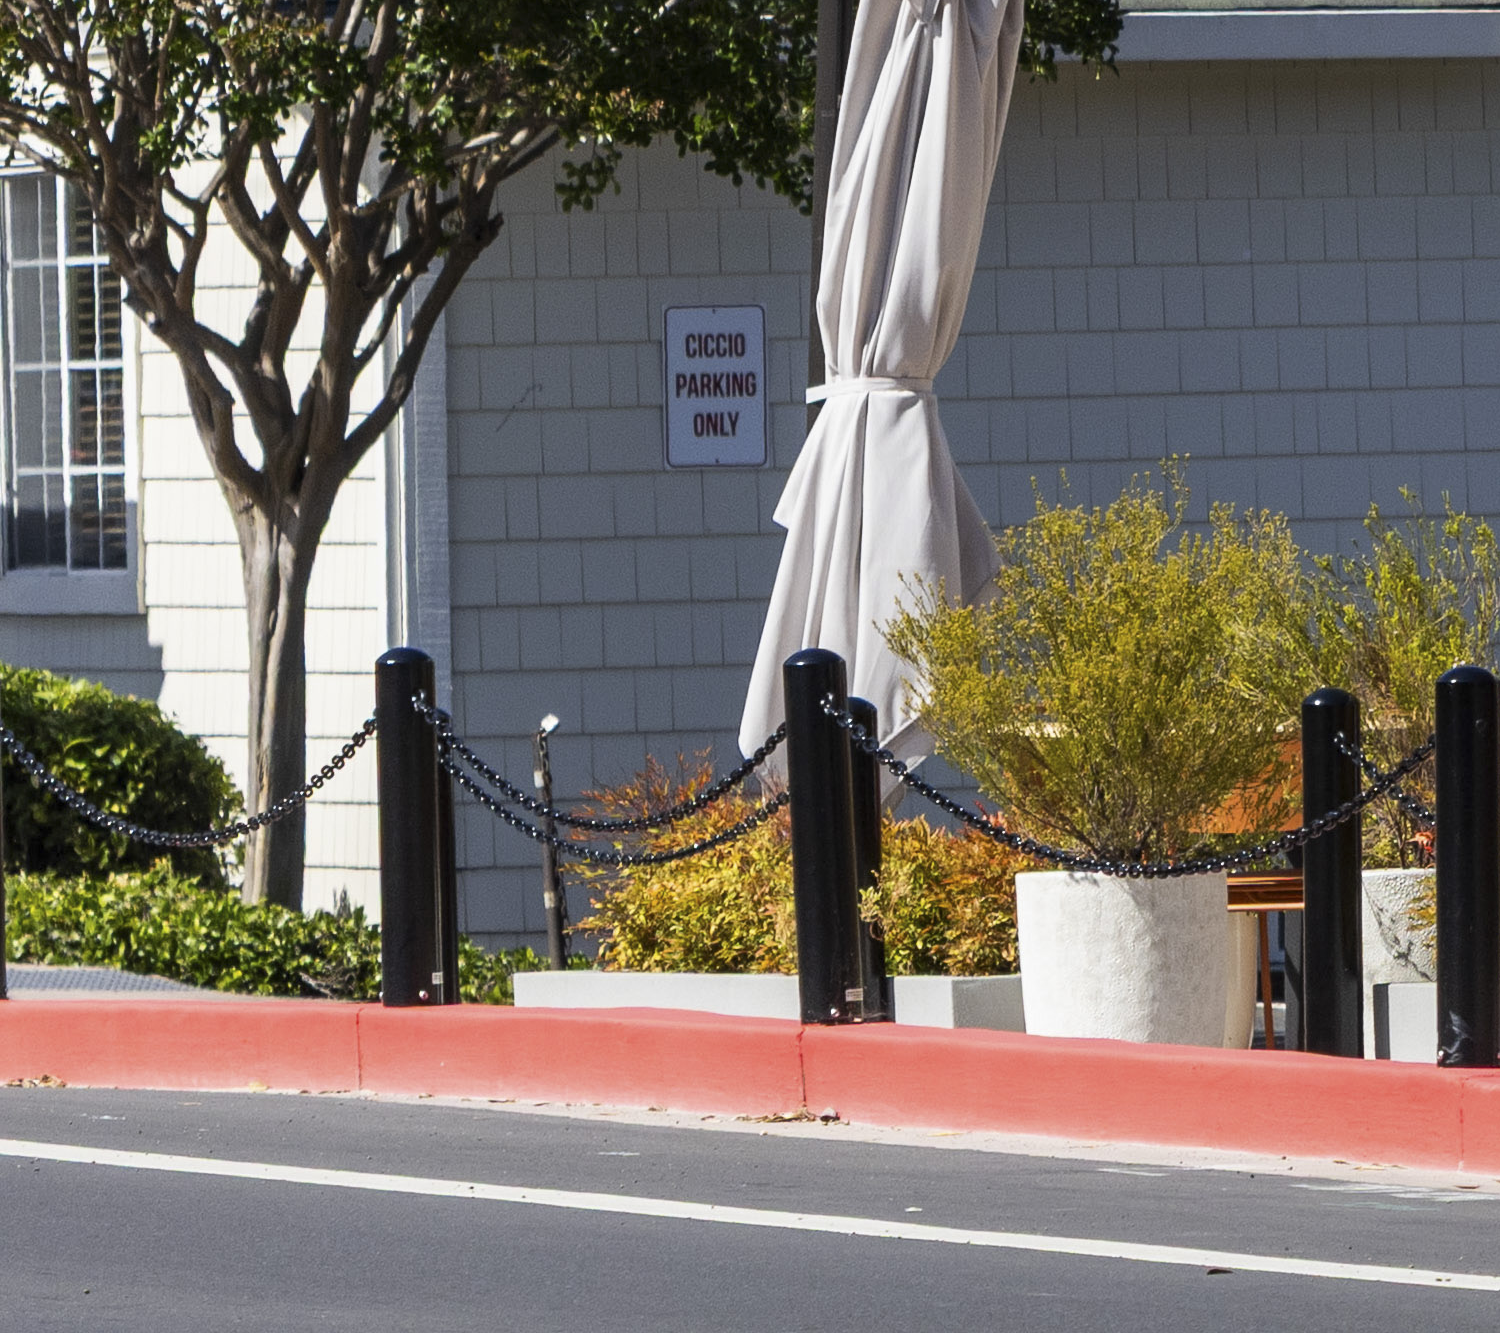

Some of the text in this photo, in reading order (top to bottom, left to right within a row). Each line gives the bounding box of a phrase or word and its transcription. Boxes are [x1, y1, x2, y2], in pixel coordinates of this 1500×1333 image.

[685, 333, 745, 359] CICCIO
[675, 372, 756, 398] PARKING
[693, 411, 739, 437] ONLY
